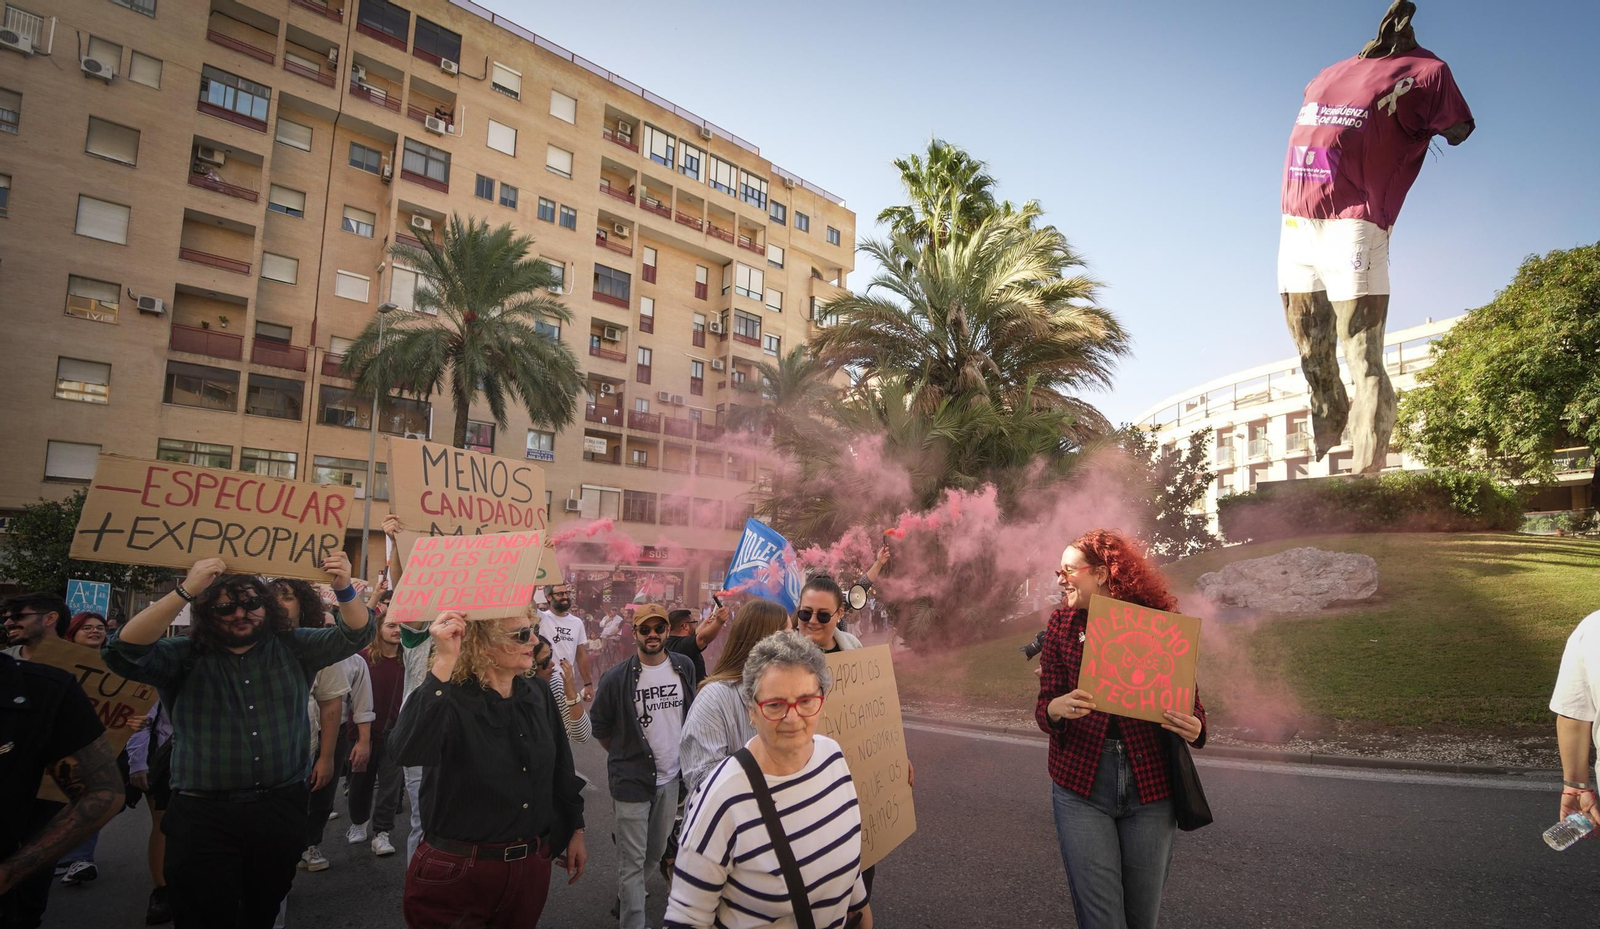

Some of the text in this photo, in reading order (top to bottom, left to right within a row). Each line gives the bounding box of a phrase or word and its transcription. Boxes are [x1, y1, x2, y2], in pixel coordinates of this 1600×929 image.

[1320, 105, 1369, 119] VERGÜENZA
[1331, 116, 1363, 128] BANDO
[422, 445, 533, 503] MENOS
[420, 490, 546, 530] CANDADOS
[415, 532, 541, 551] LA VIVIENDA
[408, 550, 521, 569] NO ES UN
[403, 567, 510, 587] LUJO ES
[397, 588, 435, 607] UN
[75, 664, 128, 697] TU
[634, 684, 678, 702] JEREZ
[889, 760, 901, 783] OS
